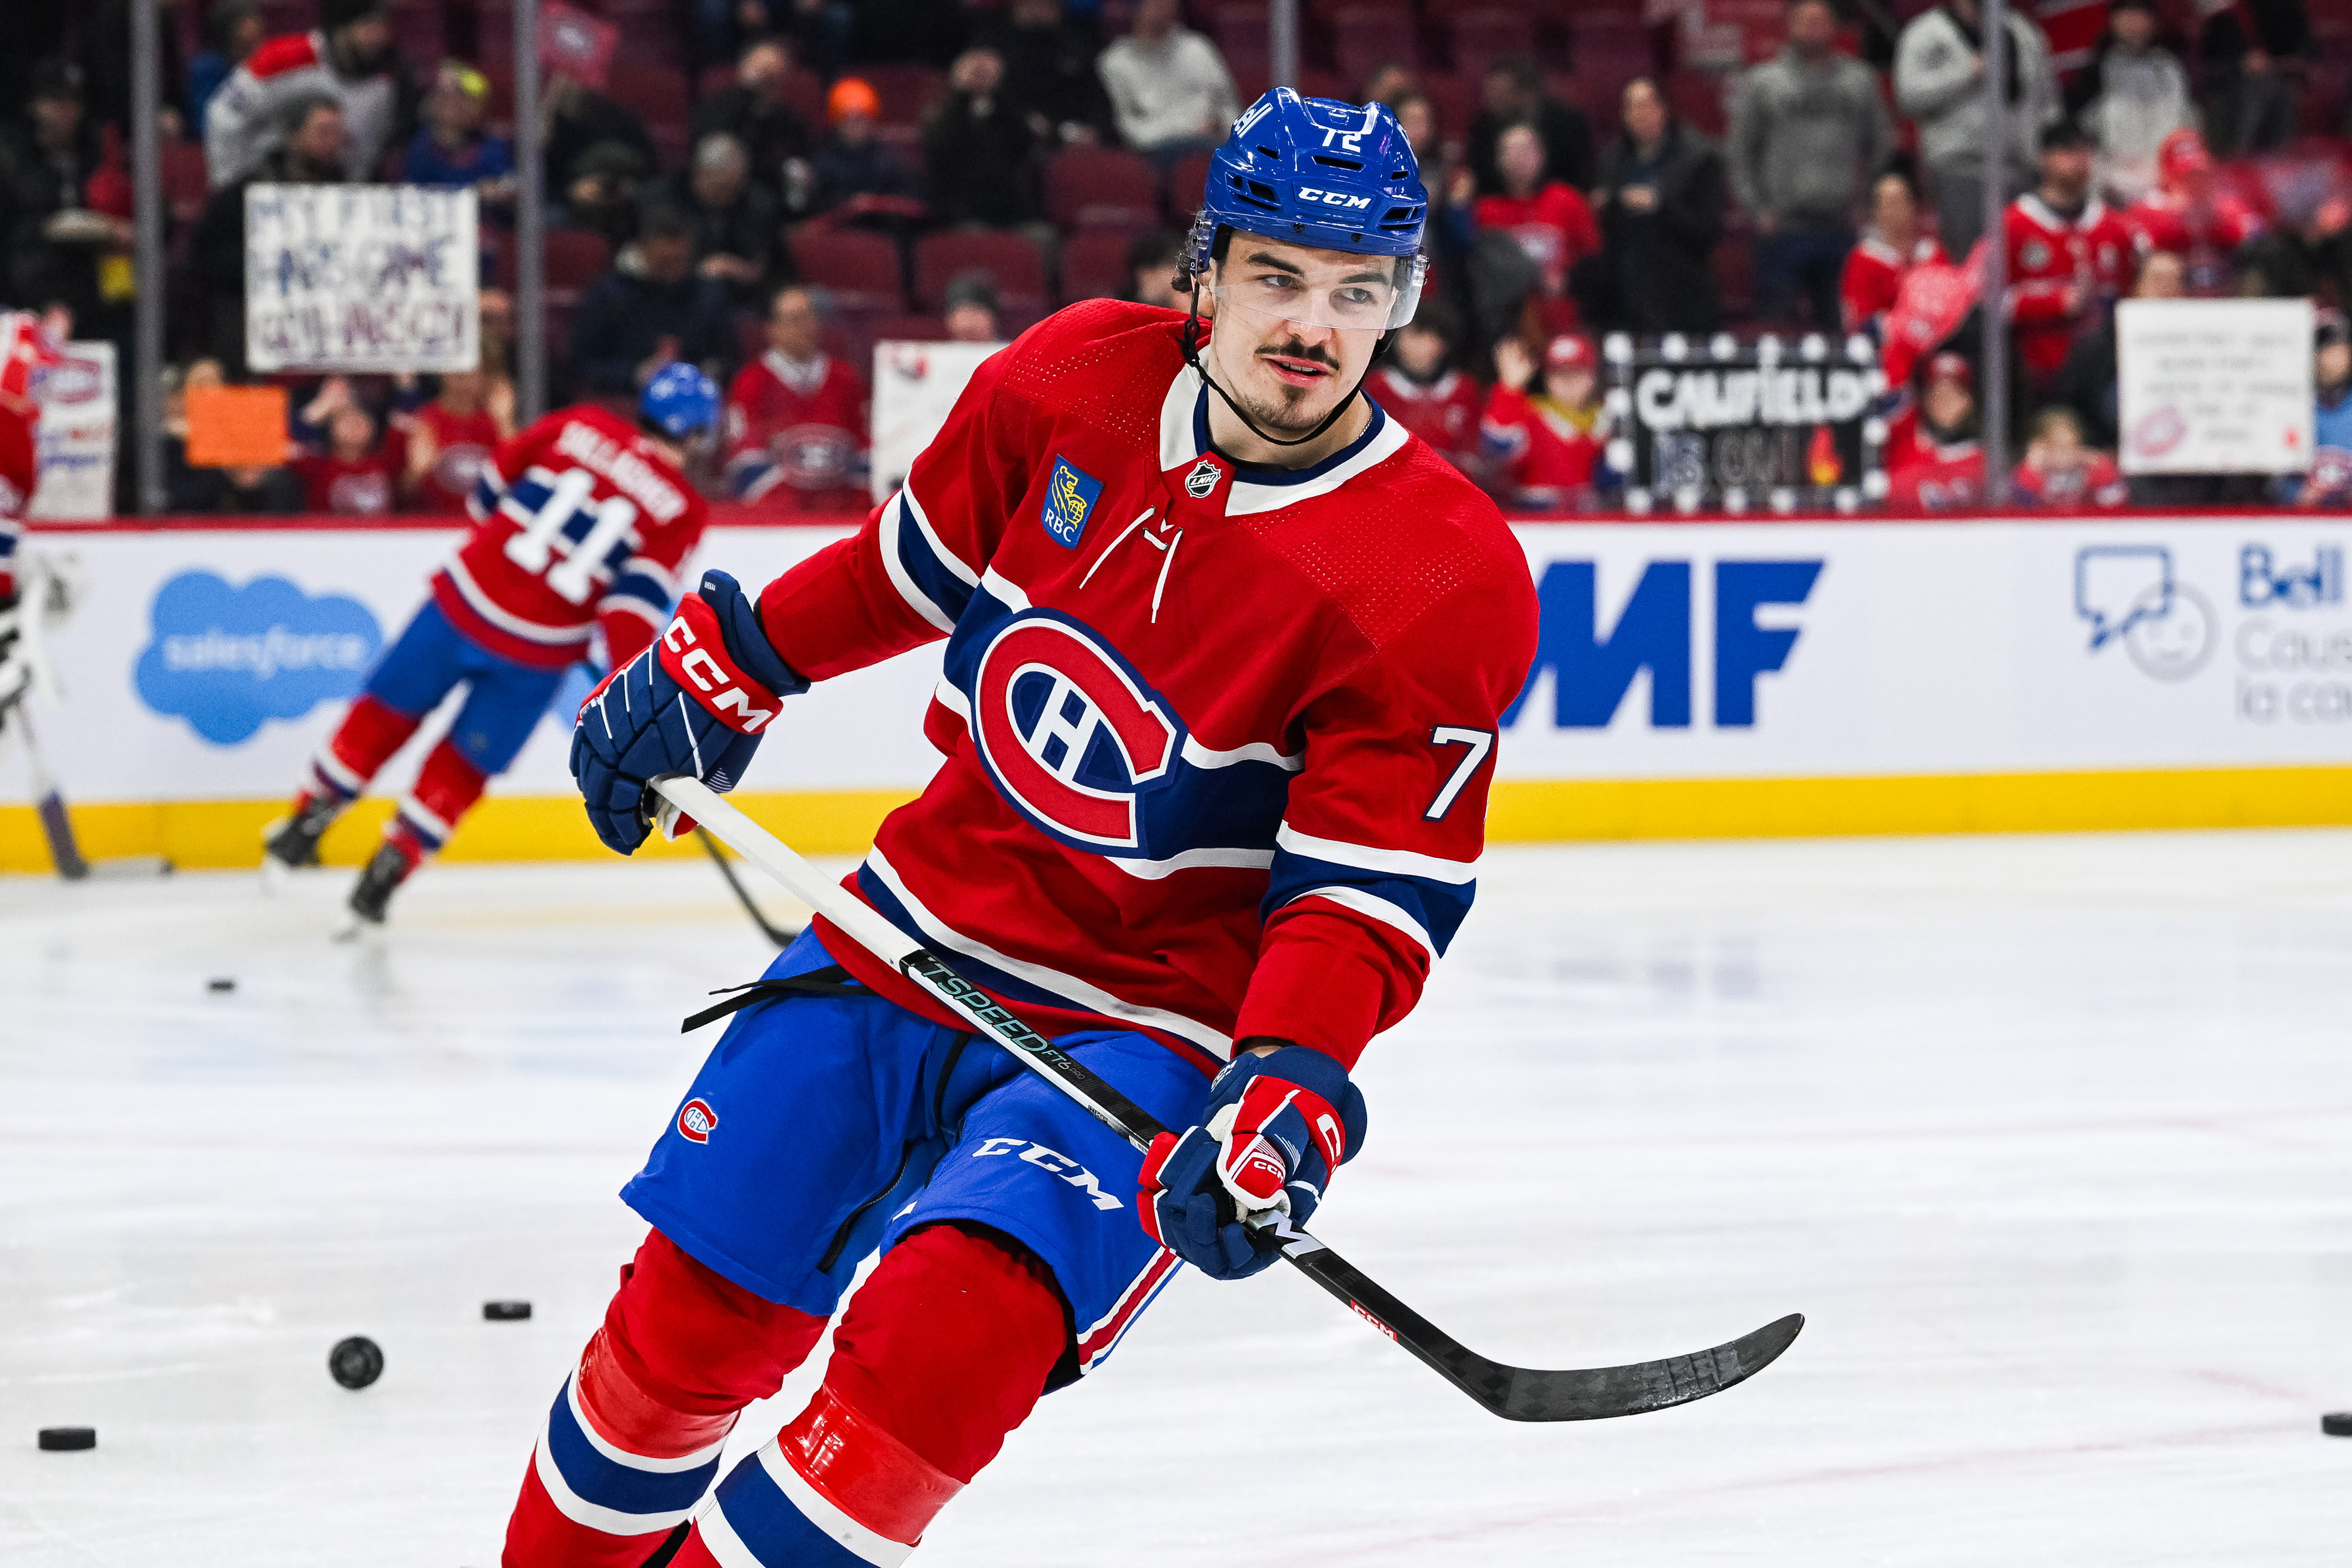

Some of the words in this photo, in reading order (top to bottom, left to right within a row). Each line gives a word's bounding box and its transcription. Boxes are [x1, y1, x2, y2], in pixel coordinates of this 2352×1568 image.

[1298, 186, 1372, 209] CCM
[1190, 474, 1216, 486] LNH
[503, 466, 641, 607] 11
[1044, 507, 1075, 543] RBC
[2239, 542, 2344, 609] Bell
[165, 624, 366, 681] salesforce
[664, 616, 773, 733] CCM
[1423, 724, 1495, 822] 7
[921, 957, 1048, 1052] TSPEED
[972, 1137, 1125, 1211] CCM
[1253, 1161, 1284, 1185] CCM
[1354, 1304, 1394, 1340] CCM
